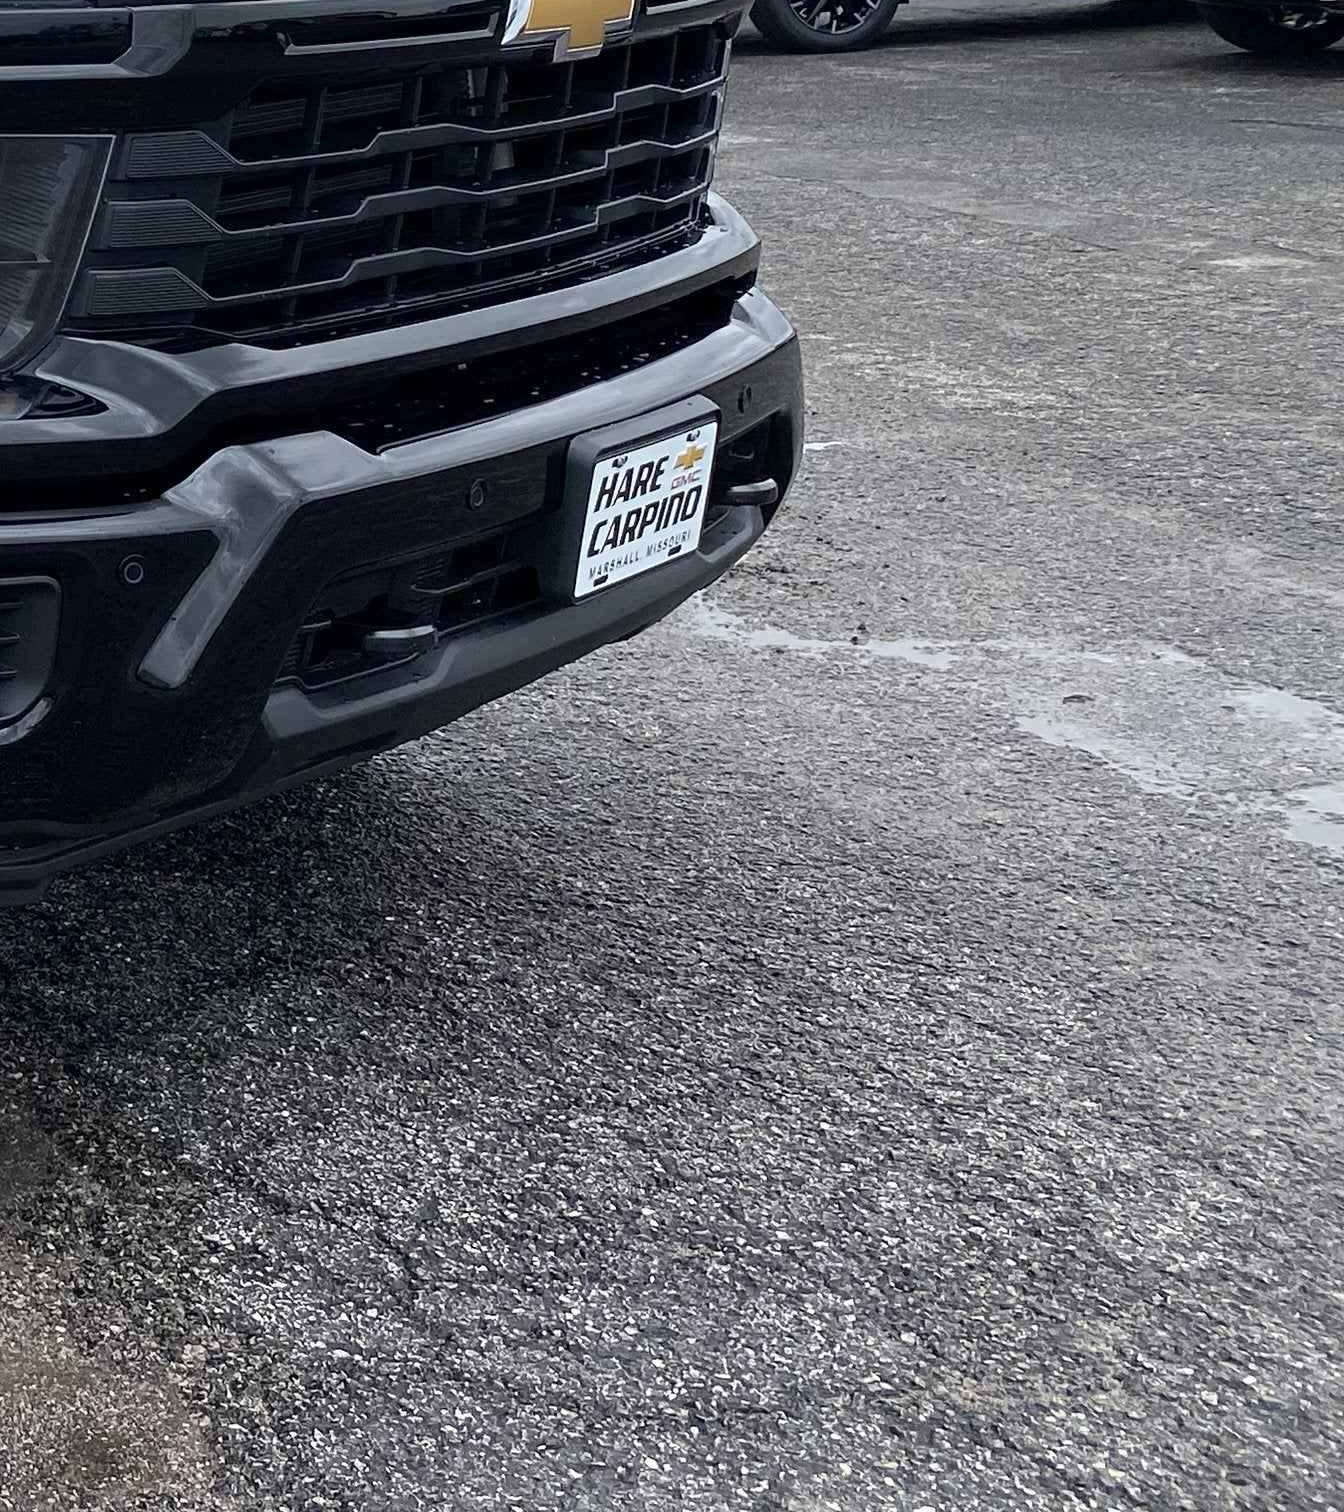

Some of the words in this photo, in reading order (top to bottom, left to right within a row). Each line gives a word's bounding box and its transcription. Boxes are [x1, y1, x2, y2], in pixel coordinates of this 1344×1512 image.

[593, 455, 669, 513] HARE
[671, 469, 702, 490] GMC
[587, 485, 703, 558] CARPINO
[646, 529, 692, 558] MISSOURI
